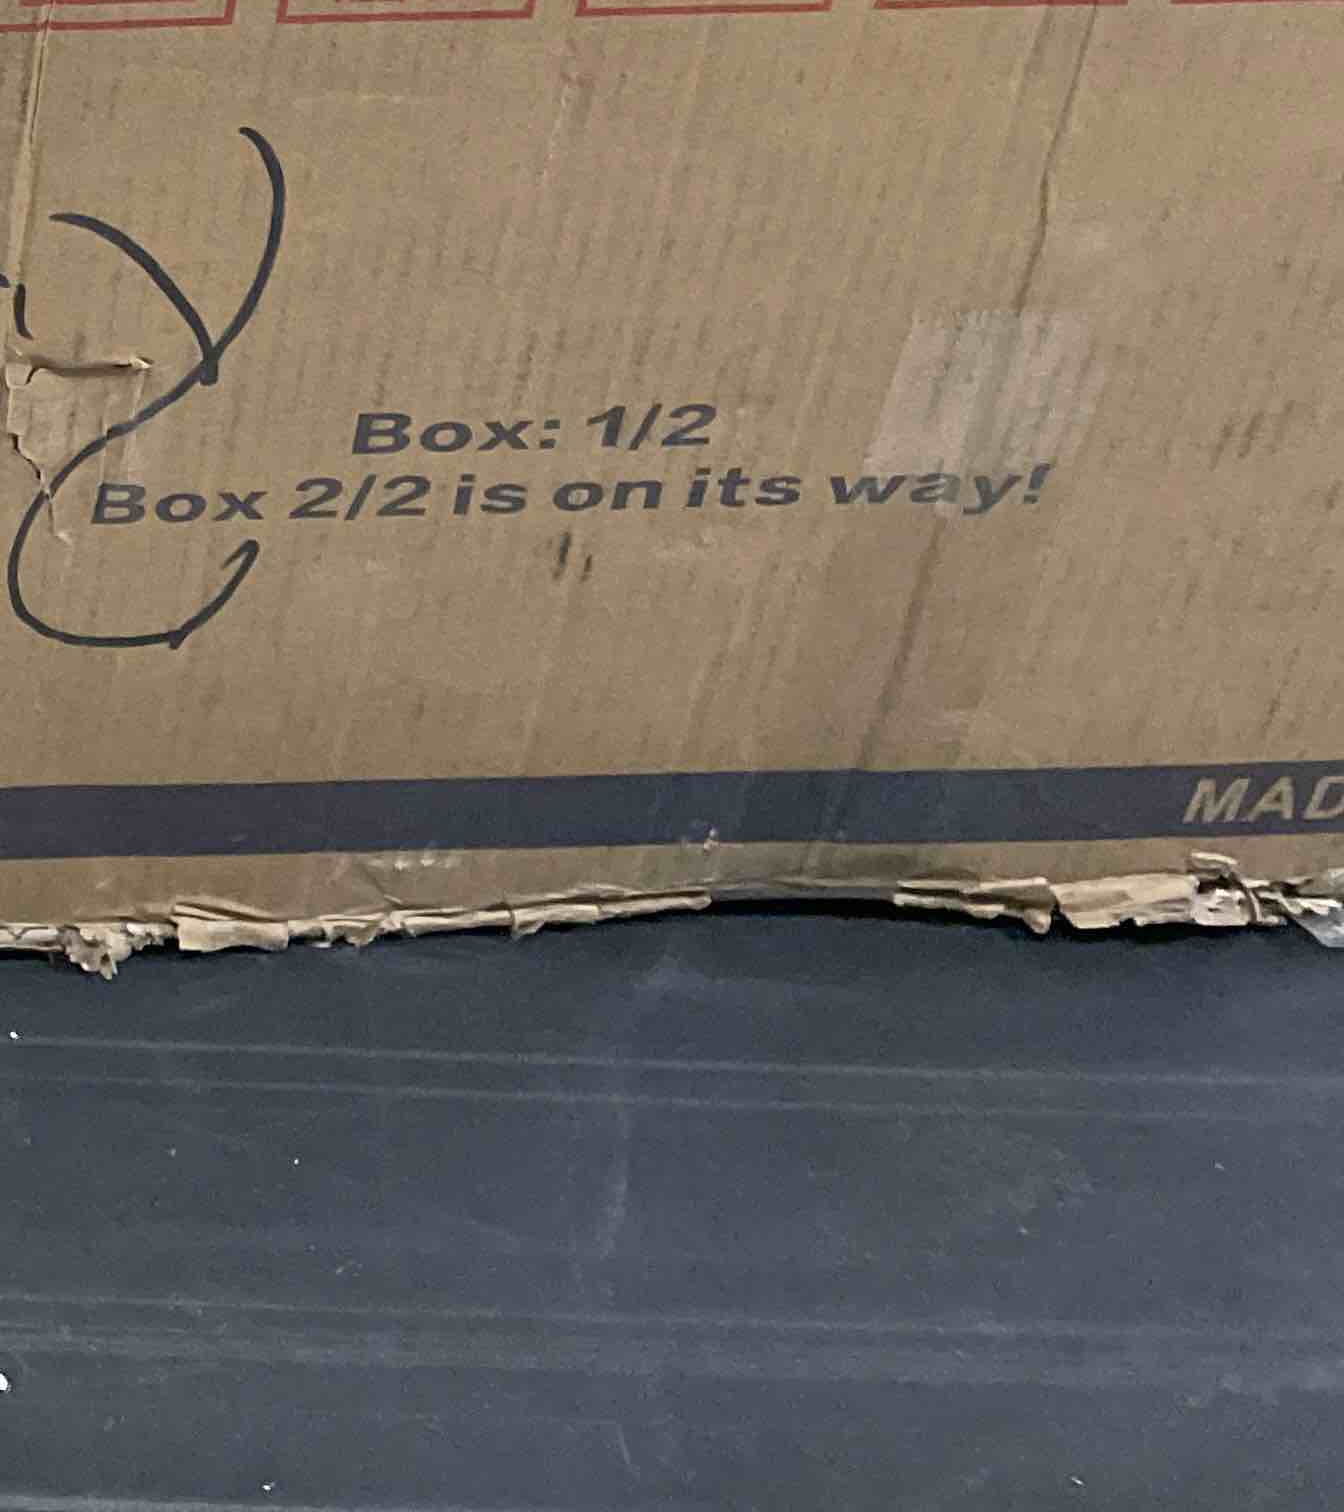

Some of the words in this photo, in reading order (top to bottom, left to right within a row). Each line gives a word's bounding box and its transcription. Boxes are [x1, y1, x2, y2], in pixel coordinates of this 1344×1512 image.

[350, 410, 562, 457] Box:
[586, 402, 718, 450] 1/2
[88, 482, 271, 527] Box
[288, 474, 433, 521] 2/2
[451, 469, 531, 516] is
[552, 476, 663, 514] on
[683, 464, 805, 511] its
[826, 461, 1055, 517] way!
